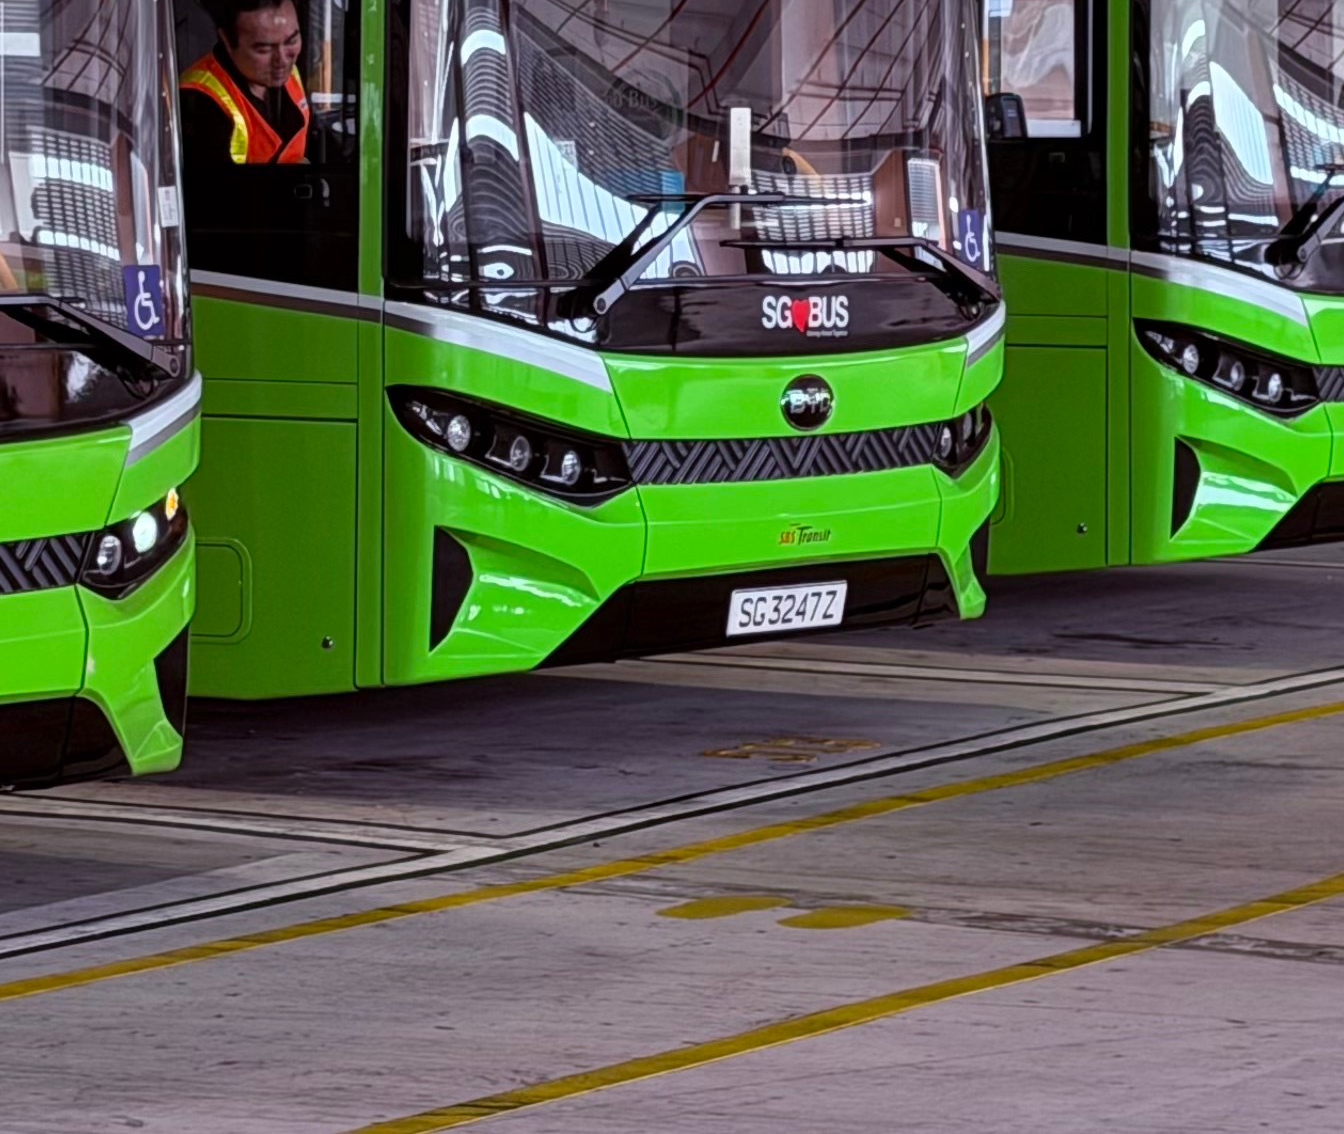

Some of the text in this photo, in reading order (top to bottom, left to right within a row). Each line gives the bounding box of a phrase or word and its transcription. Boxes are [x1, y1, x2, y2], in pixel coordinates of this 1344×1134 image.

[761, 295, 849, 329] SG BUS
[739, 590, 838, 628] SG3247Z
